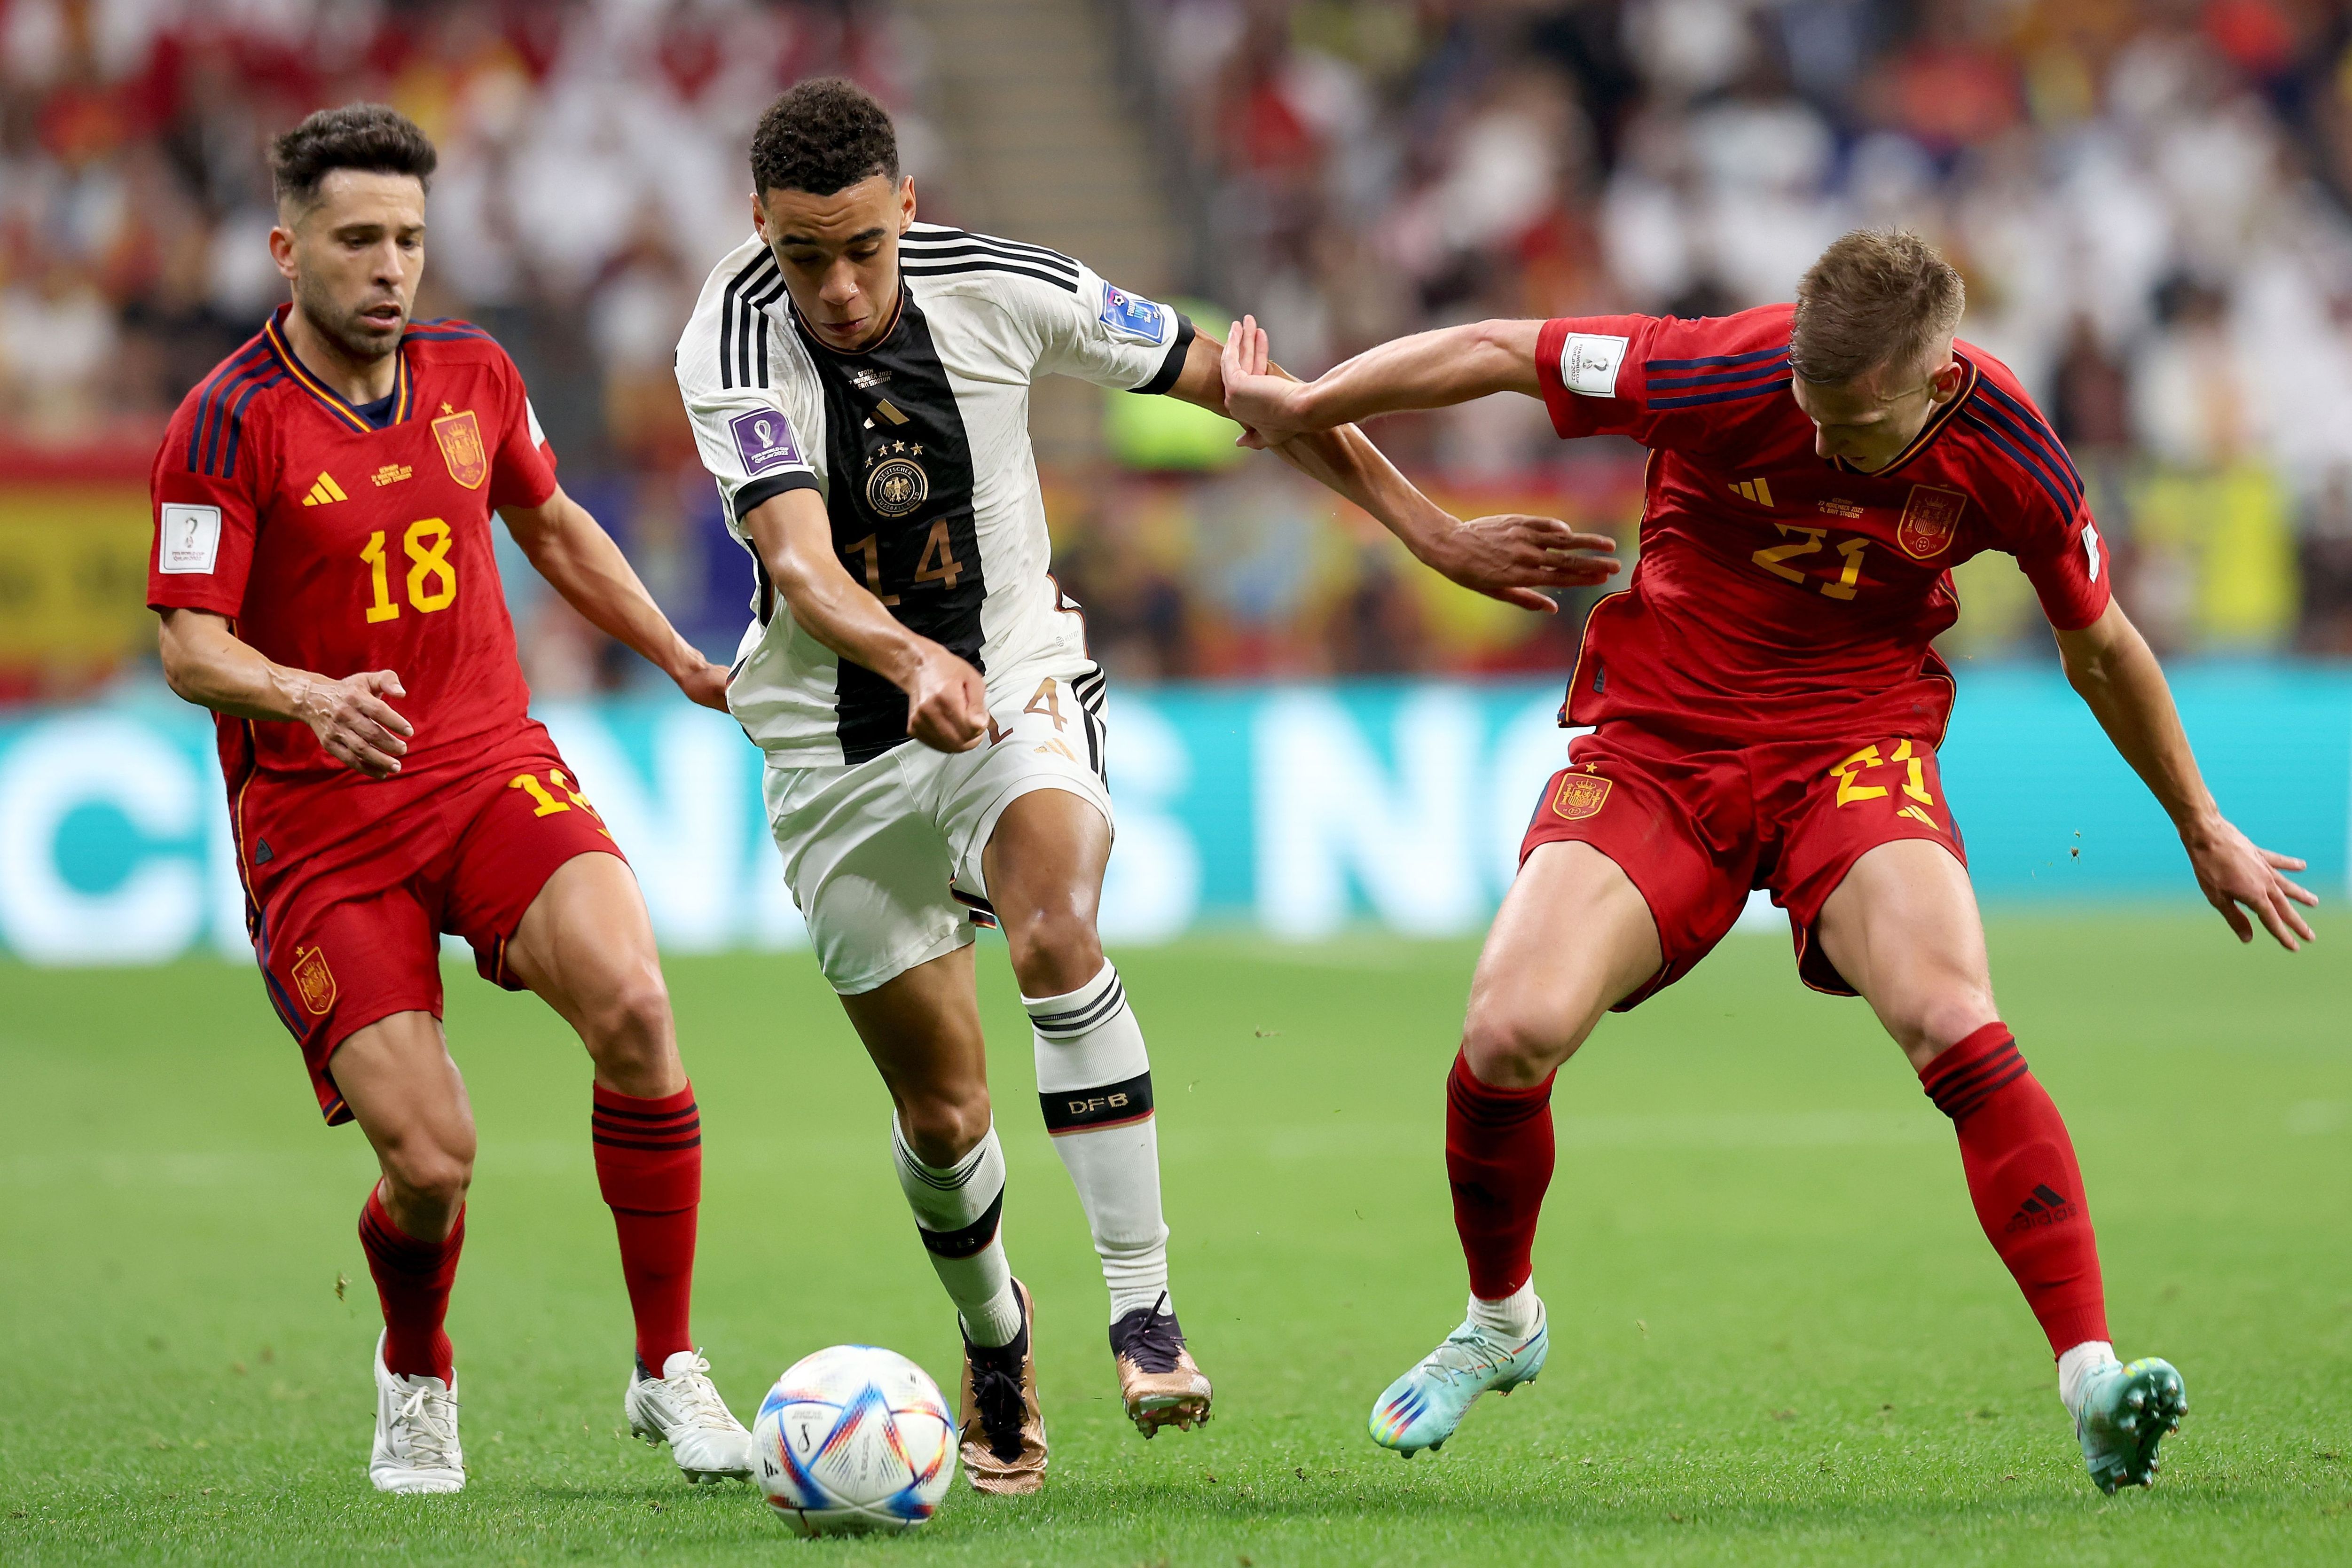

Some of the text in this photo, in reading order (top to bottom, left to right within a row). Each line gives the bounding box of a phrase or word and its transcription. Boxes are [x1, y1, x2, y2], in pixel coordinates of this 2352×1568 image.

[853, 373, 878, 385] NOVEMBER
[857, 368, 874, 378] SPAIN
[868, 376, 891, 387] STADIUM
[878, 467, 913, 482] DEUTSCHER
[1826, 502, 1850, 511] NOVEMBER
[1840, 510, 1859, 519] STADIUM
[360, 517, 457, 624] 18
[845, 517, 963, 606] 14
[1751, 522, 1871, 601] 21
[1828, 738, 1934, 808] 21
[1068, 1092, 1129, 1114] DFB
[2005, 1202, 2078, 1234] adidas
